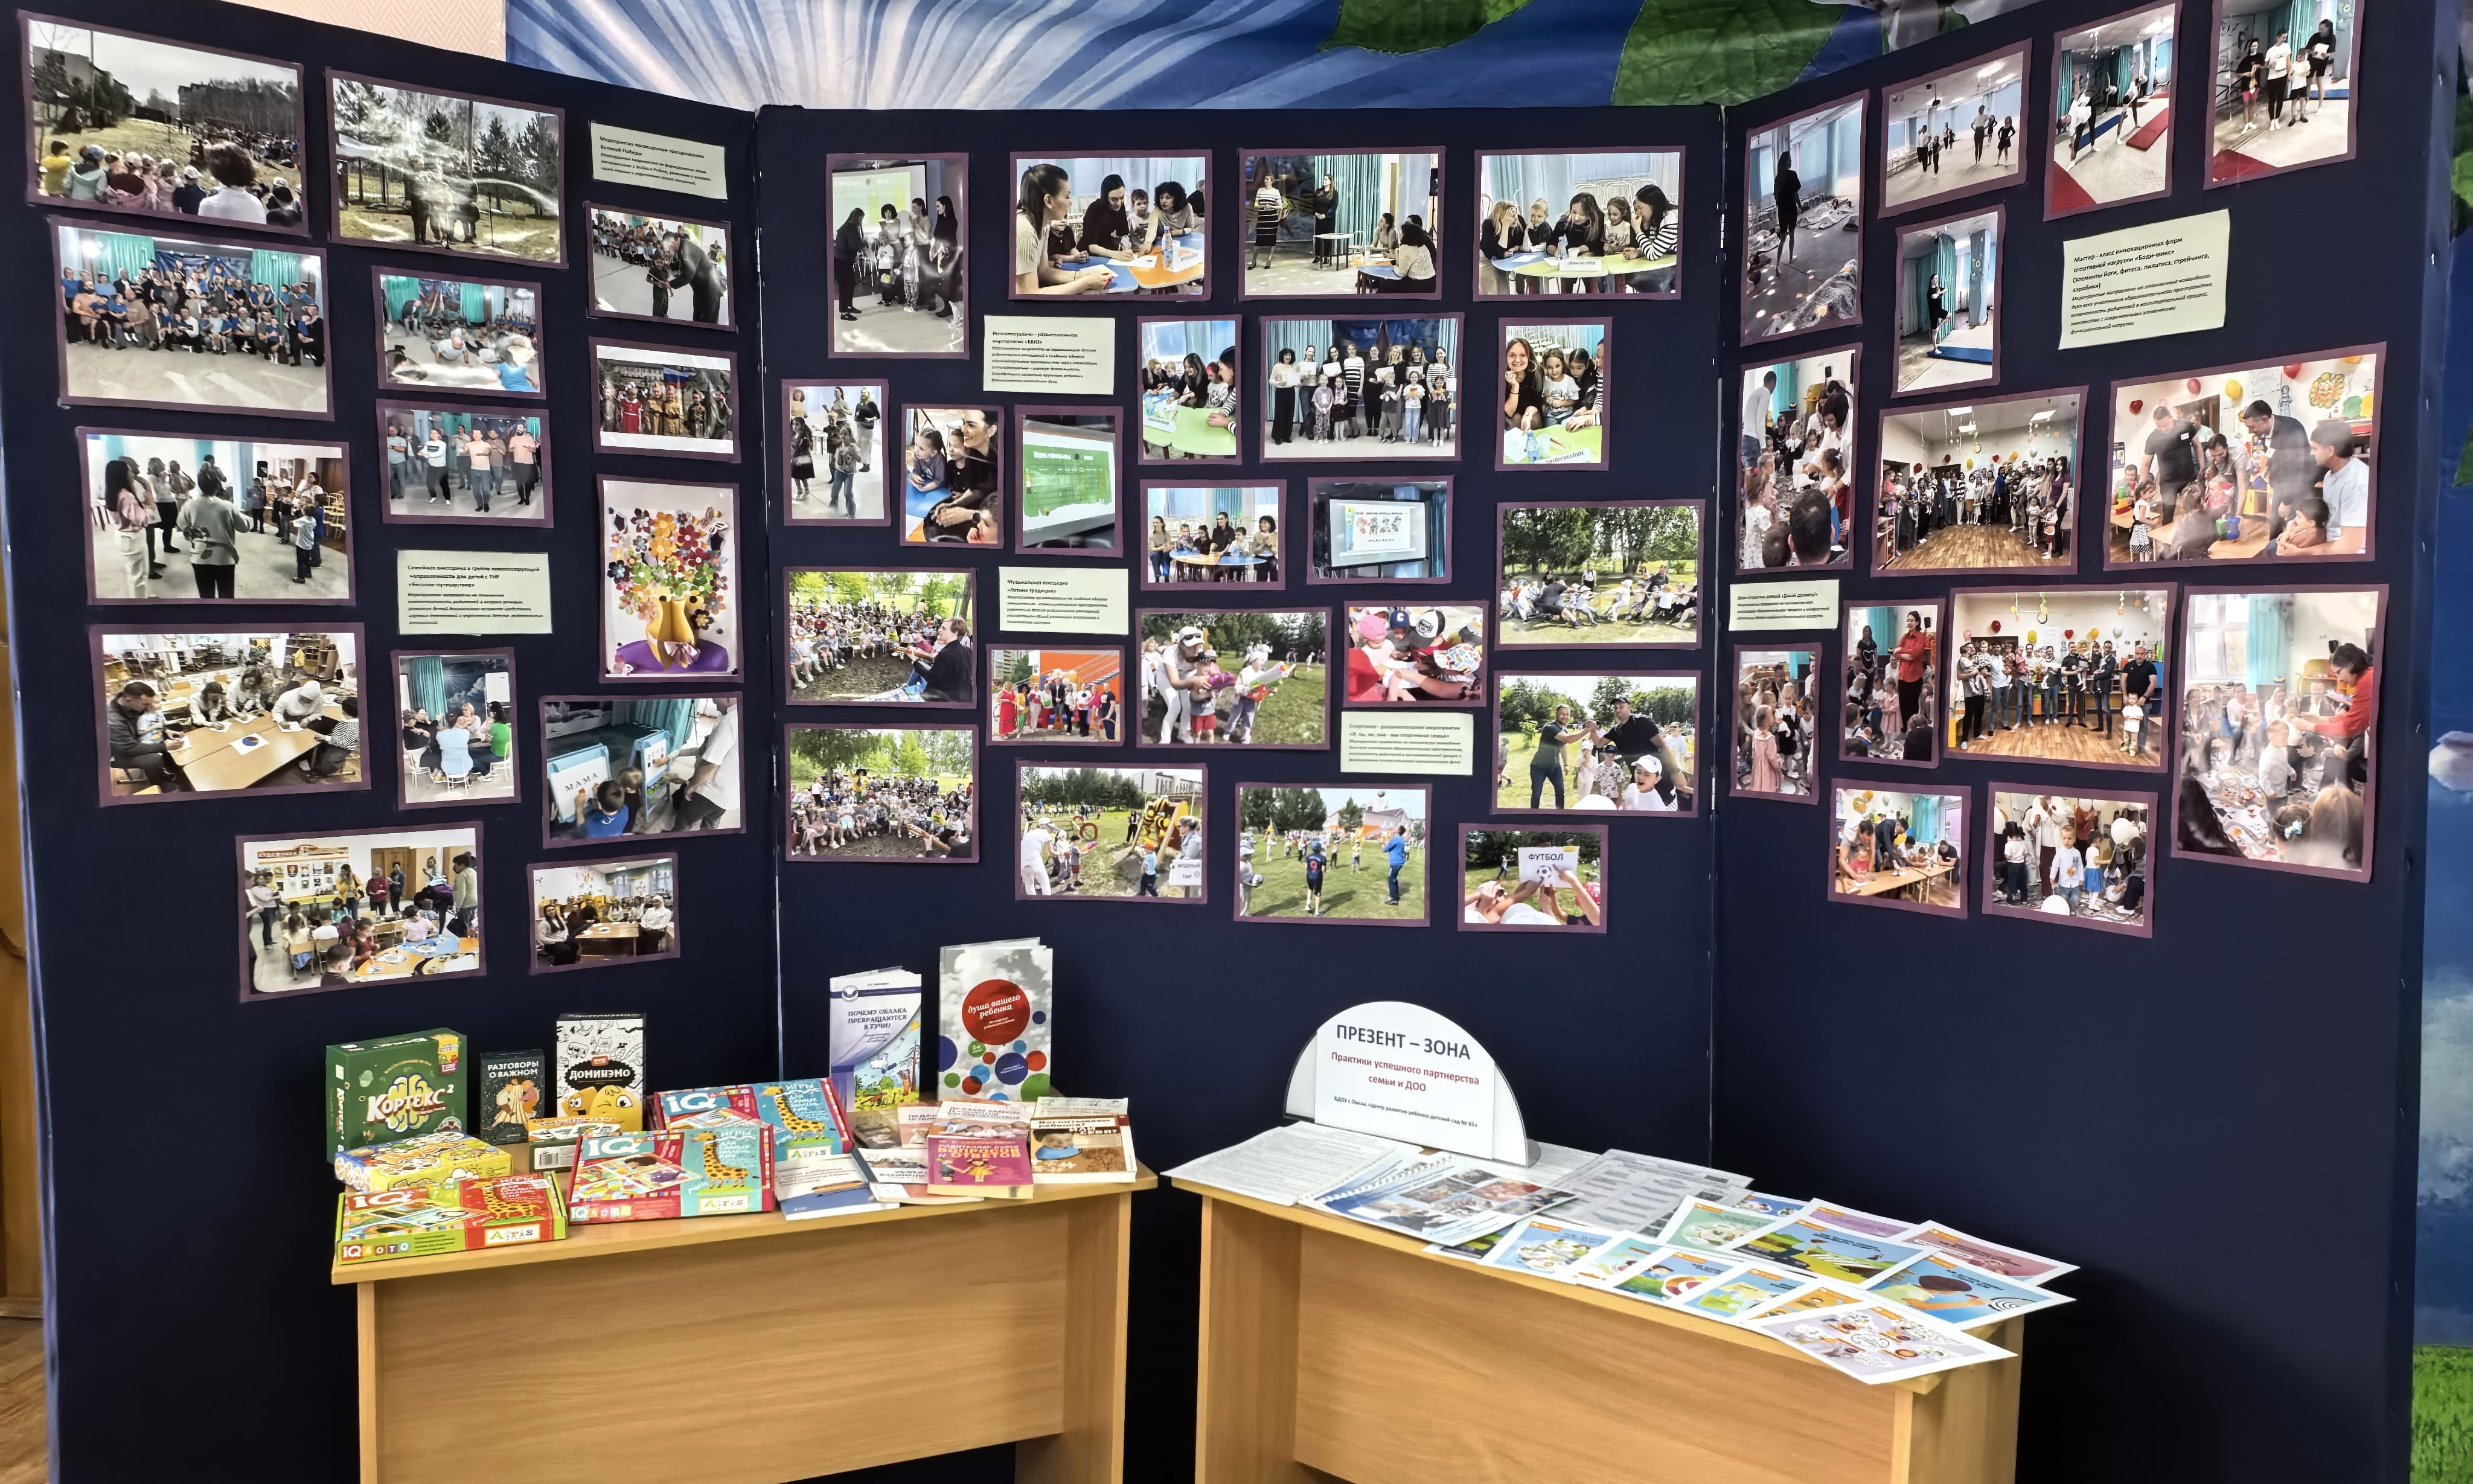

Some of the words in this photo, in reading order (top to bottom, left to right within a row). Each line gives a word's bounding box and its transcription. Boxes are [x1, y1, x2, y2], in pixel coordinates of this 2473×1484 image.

[2165, 237, 2183, 246] форм
[1310, 861, 1317, 873] 9
[968, 1002, 990, 1014] душа
[991, 994, 1020, 1008] вашего
[979, 1004, 1012, 1020] ребенка
[848, 1014, 907, 1024] ПРЕВРАЩАЮТСЯ
[1337, 1024, 1406, 1048] ПРЕЗЕНТ
[1424, 1038, 1471, 1060] ЗОНА
[488, 1060, 539, 1070] РАЗГОВОРЫ
[1332, 1052, 1372, 1066] Практики
[1374, 1060, 1421, 1075] успешного
[1423, 1068, 1479, 1085] партнерства
[497, 1069, 537, 1078] ВАЖНОМ
[569, 1069, 630, 1081] ДОМИНЭМО
[447, 1084, 454, 1093] 2
[1369, 1075, 1396, 1086] семьи
[1405, 1081, 1426, 1092] ДОО
